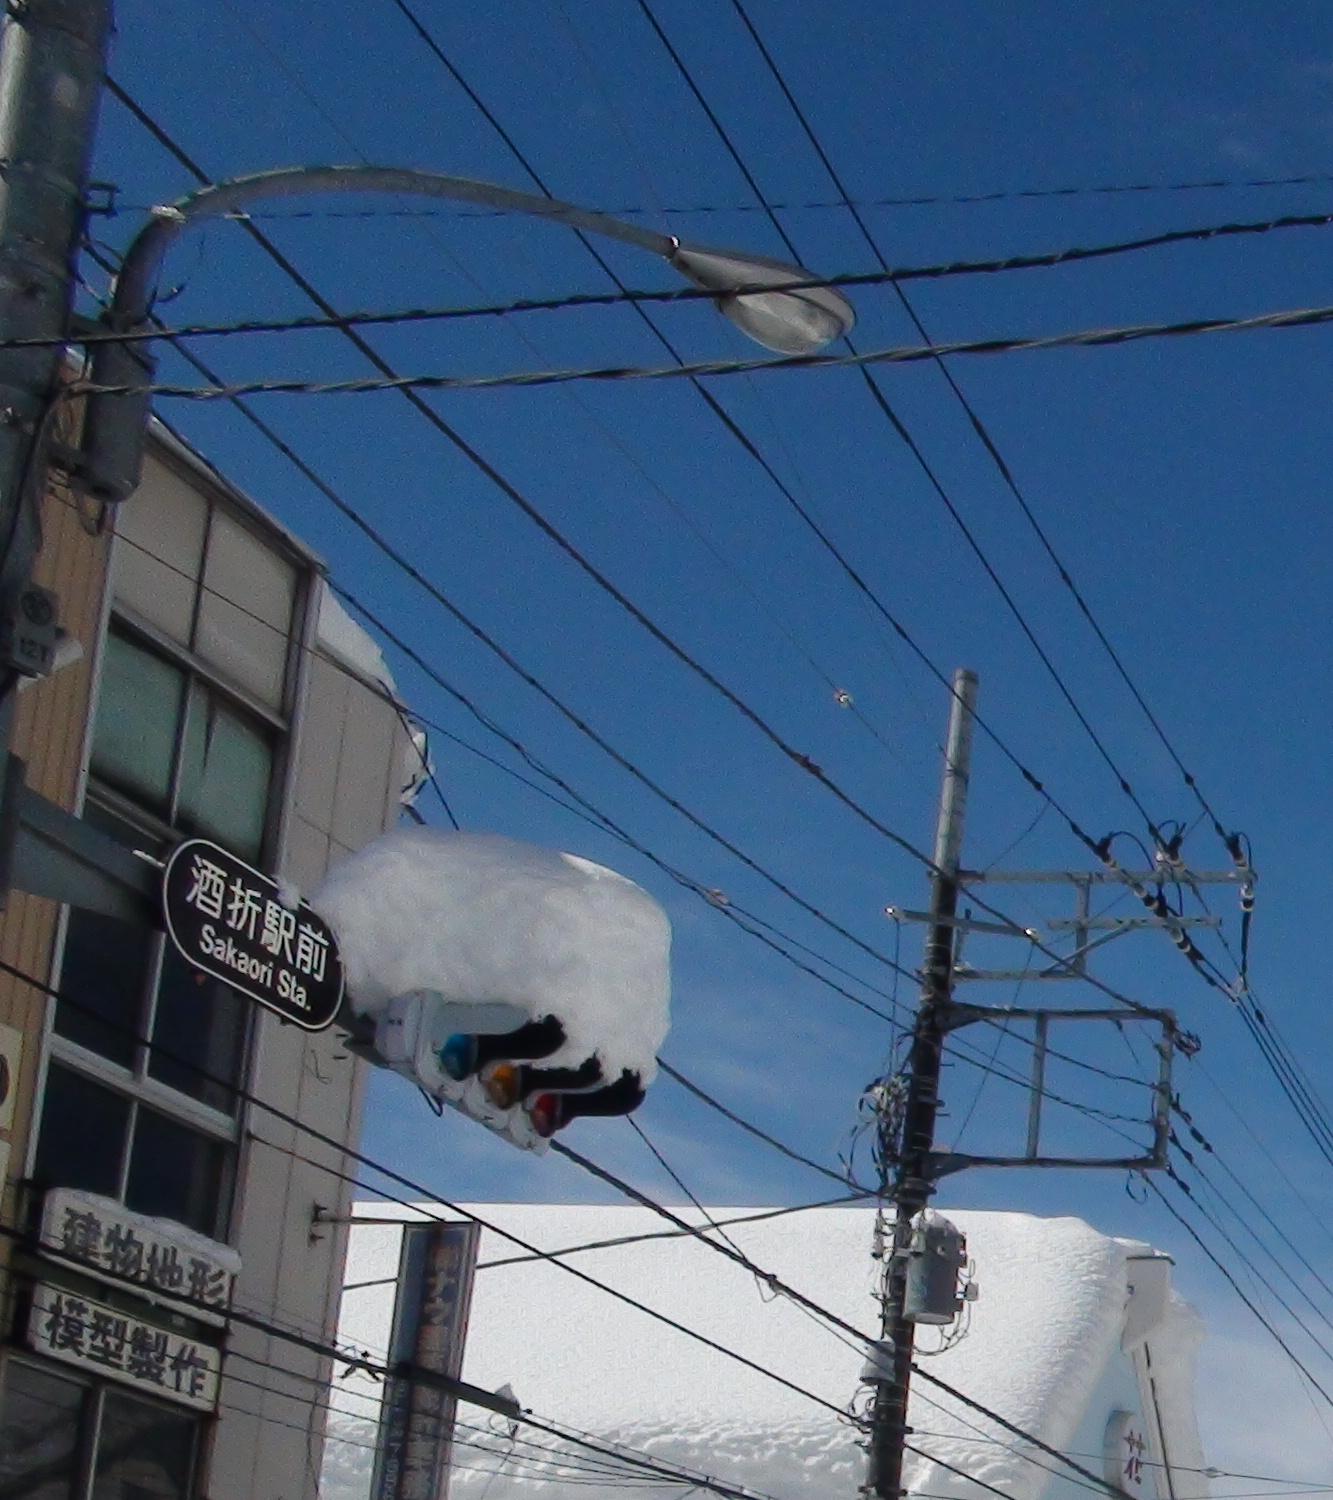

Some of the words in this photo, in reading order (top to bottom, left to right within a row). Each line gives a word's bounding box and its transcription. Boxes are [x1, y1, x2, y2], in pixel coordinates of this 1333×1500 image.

[186, 854, 330, 983] 酒折駅前
[200, 924, 273, 988] Sakaori
[277, 969, 312, 1011] Sta.
[63, 1207, 228, 1306] 建物地形
[45, 1293, 208, 1398] 模型製作
